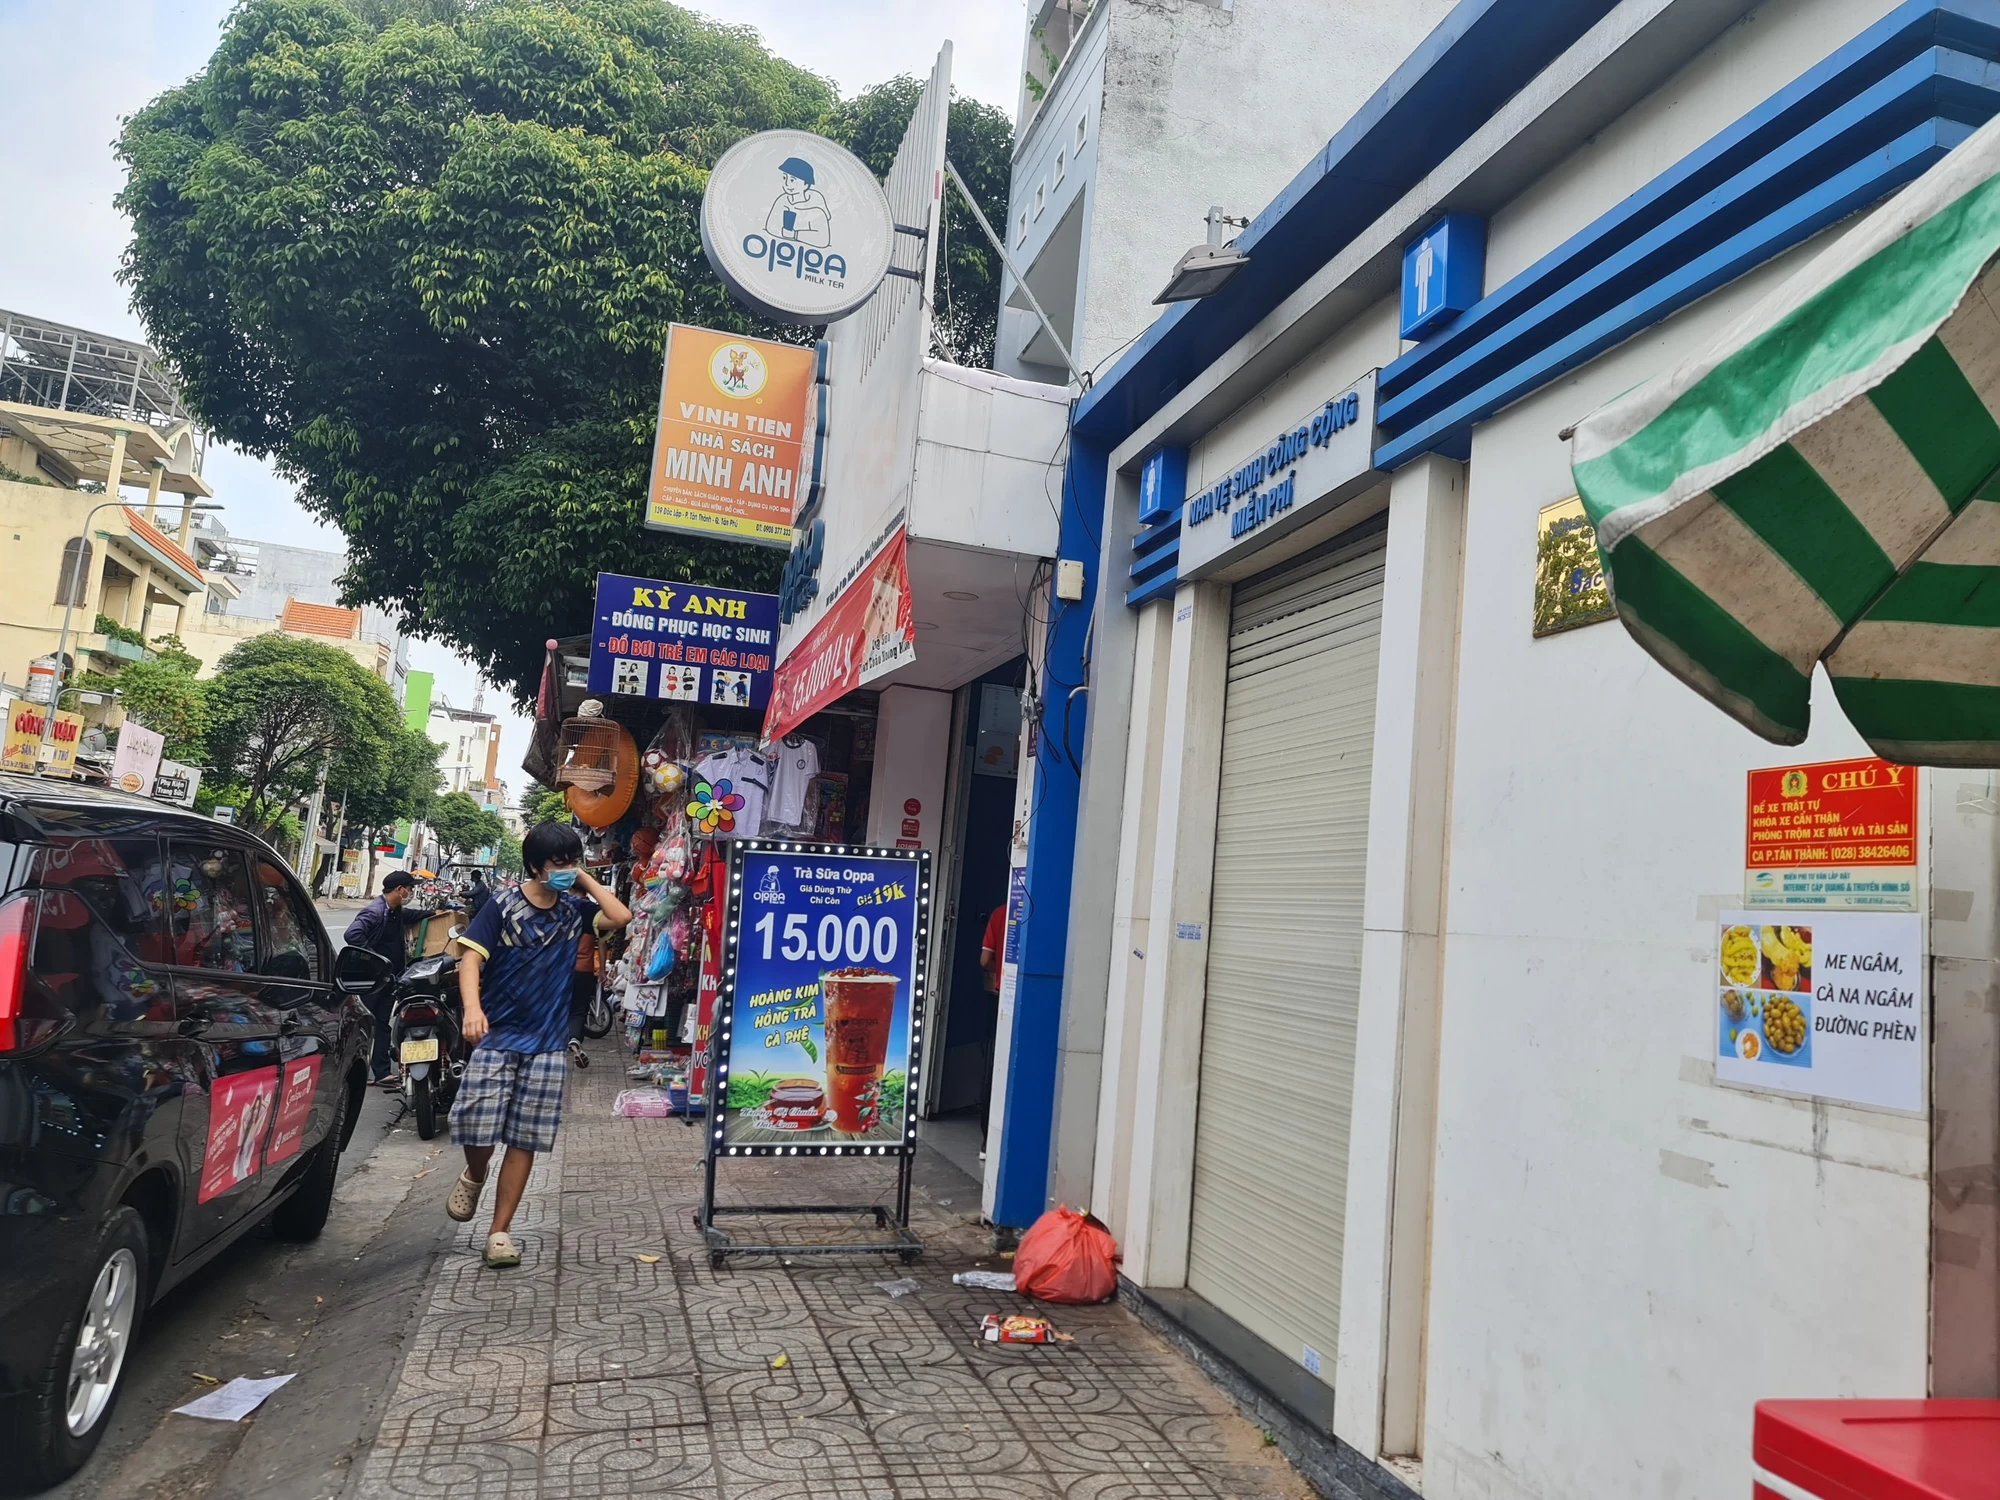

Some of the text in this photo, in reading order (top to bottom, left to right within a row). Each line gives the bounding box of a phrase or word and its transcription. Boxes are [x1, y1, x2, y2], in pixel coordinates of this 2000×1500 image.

[804, 274, 844, 289] MILK TEA
[680, 402, 792, 438] VINH TIEN
[689, 430, 775, 459] NHÀ SÁCH
[1211, 475, 1232, 514] VỆ
[1231, 454, 1265, 499] SINH
[1265, 426, 1309, 476] CÔNG
[1309, 391, 1358, 448] CỘNG
[665, 447, 792, 500] MINH ANH
[1267, 469, 1296, 517] PHÍ
[632, 585, 747, 620] KỲ ANH
[658, 617, 699, 640] PHỤC
[702, 623, 732, 642] HỌC
[735, 627, 771, 645] SINH
[631, 640, 655, 657] BƠI
[658, 640, 683, 661] TRẺ
[686, 646, 707, 663] EM
[710, 647, 737, 667] CÁC
[740, 652, 770, 673] LOẠI
[1822, 764, 1904, 790] CHÚ Ý
[1753, 798, 1821, 814] ĐỂ XE TRẬT TỰ
[1753, 810, 1840, 827] KHÓA XE CẨN THẬN
[1753, 820, 1908, 841] PHÒNG TRỘM XE MÁY VÀ TÀI SẢN
[1752, 845, 1909, 862] CA P.TÂN THÀNH: (028) 38426406
[794, 867, 874, 884] Trà Sữa Oppa
[800, 885, 852, 894] Giá Dùng Thử
[825, 897, 840, 905] Còn
[857, 894, 873, 906] Giá
[755, 912, 898, 963] 15.000
[1825, 952, 1903, 975] ME NGÂM,
[749, 983, 819, 1008] HOÀNG KIM
[1816, 983, 1914, 1009] CÀ NA NGÂM
[754, 1003, 816, 1028] HỒNG TRÀ
[765, 1025, 810, 1048] CÀ PHÊ
[1815, 1016, 1916, 1042] ĐƯỜNG PHÈN
